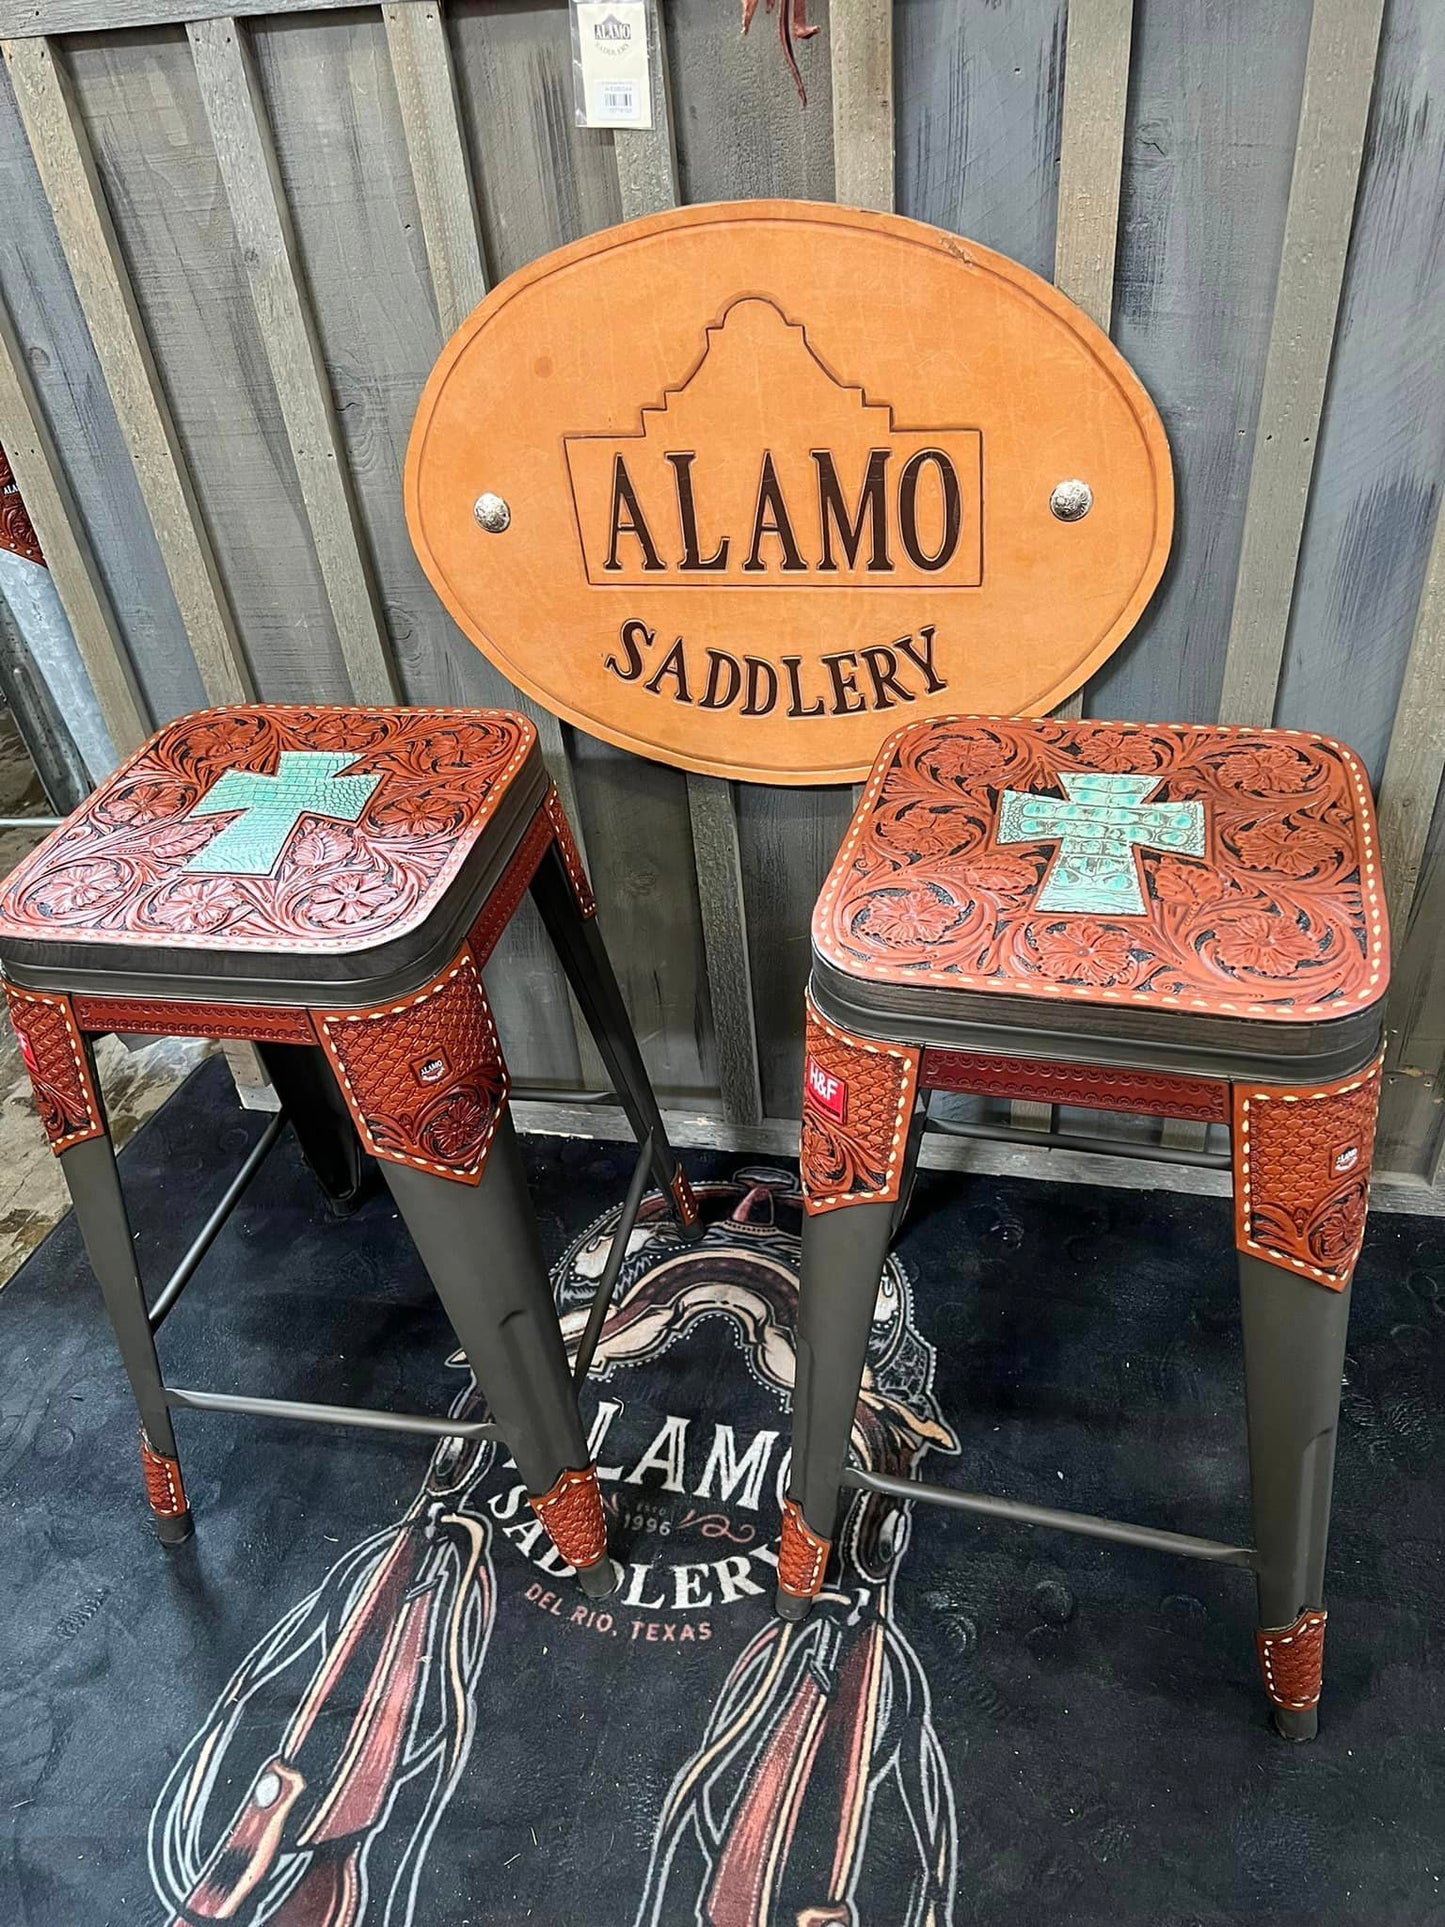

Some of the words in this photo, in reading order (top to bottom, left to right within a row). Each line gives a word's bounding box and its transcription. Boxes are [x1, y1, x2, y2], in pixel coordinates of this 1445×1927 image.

[602, 447, 963, 573] ALAMO
[603, 618, 948, 718] SADDLERY
[809, 1061, 839, 1101] H&F
[623, 1513, 672, 1536] 1996
[525, 1582, 562, 1616] DEL
[570, 1604, 618, 1637] RIO,
[631, 1620, 713, 1642] TEXAS
